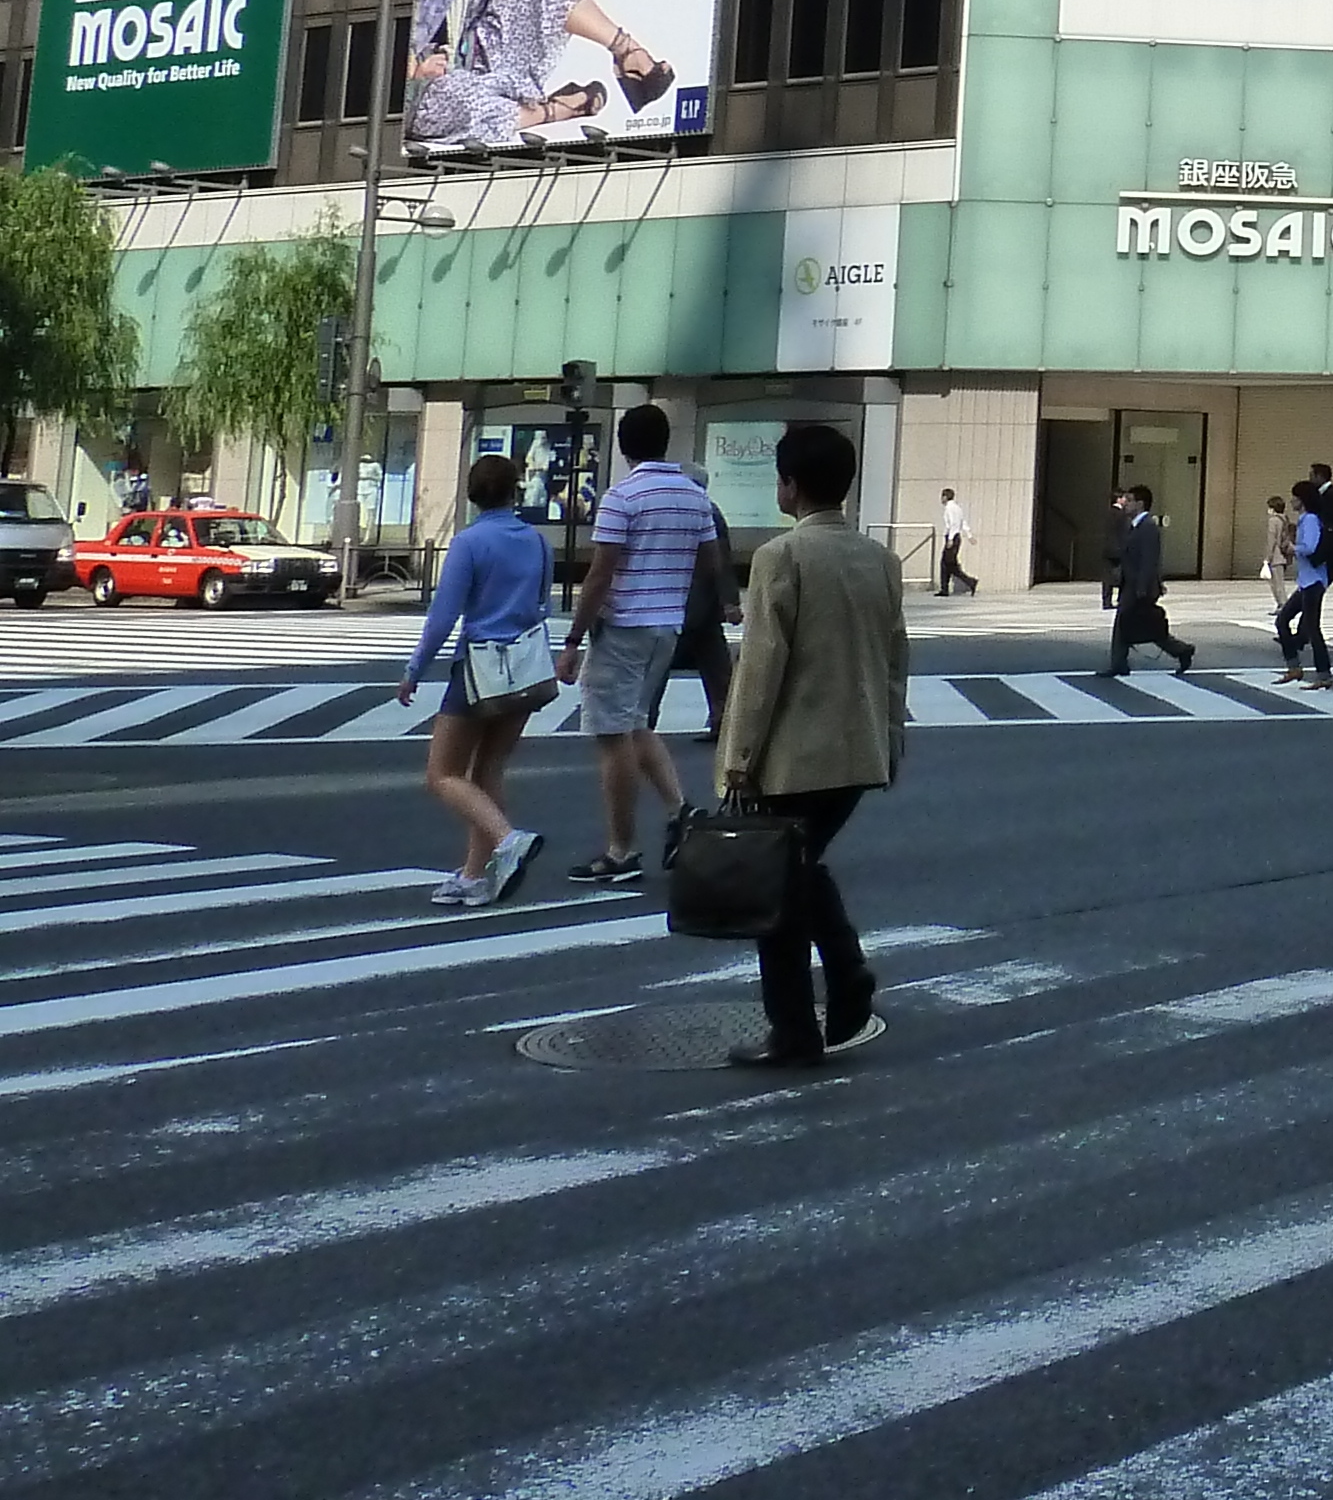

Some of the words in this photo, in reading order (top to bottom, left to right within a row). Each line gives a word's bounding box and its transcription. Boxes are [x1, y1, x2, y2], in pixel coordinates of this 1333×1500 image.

[66, 75, 96, 92] New
[98, 70, 145, 90] Quality
[147, 66, 168, 84] for
[170, 63, 213, 82] Better
[214, 59, 241, 77] Life
[680, 99, 701, 120] GAP
[625, 114, 672, 131] gap.co.jp
[1178, 158, 1299, 190] 銀座阪急
[824, 264, 885, 286] AIGLE
